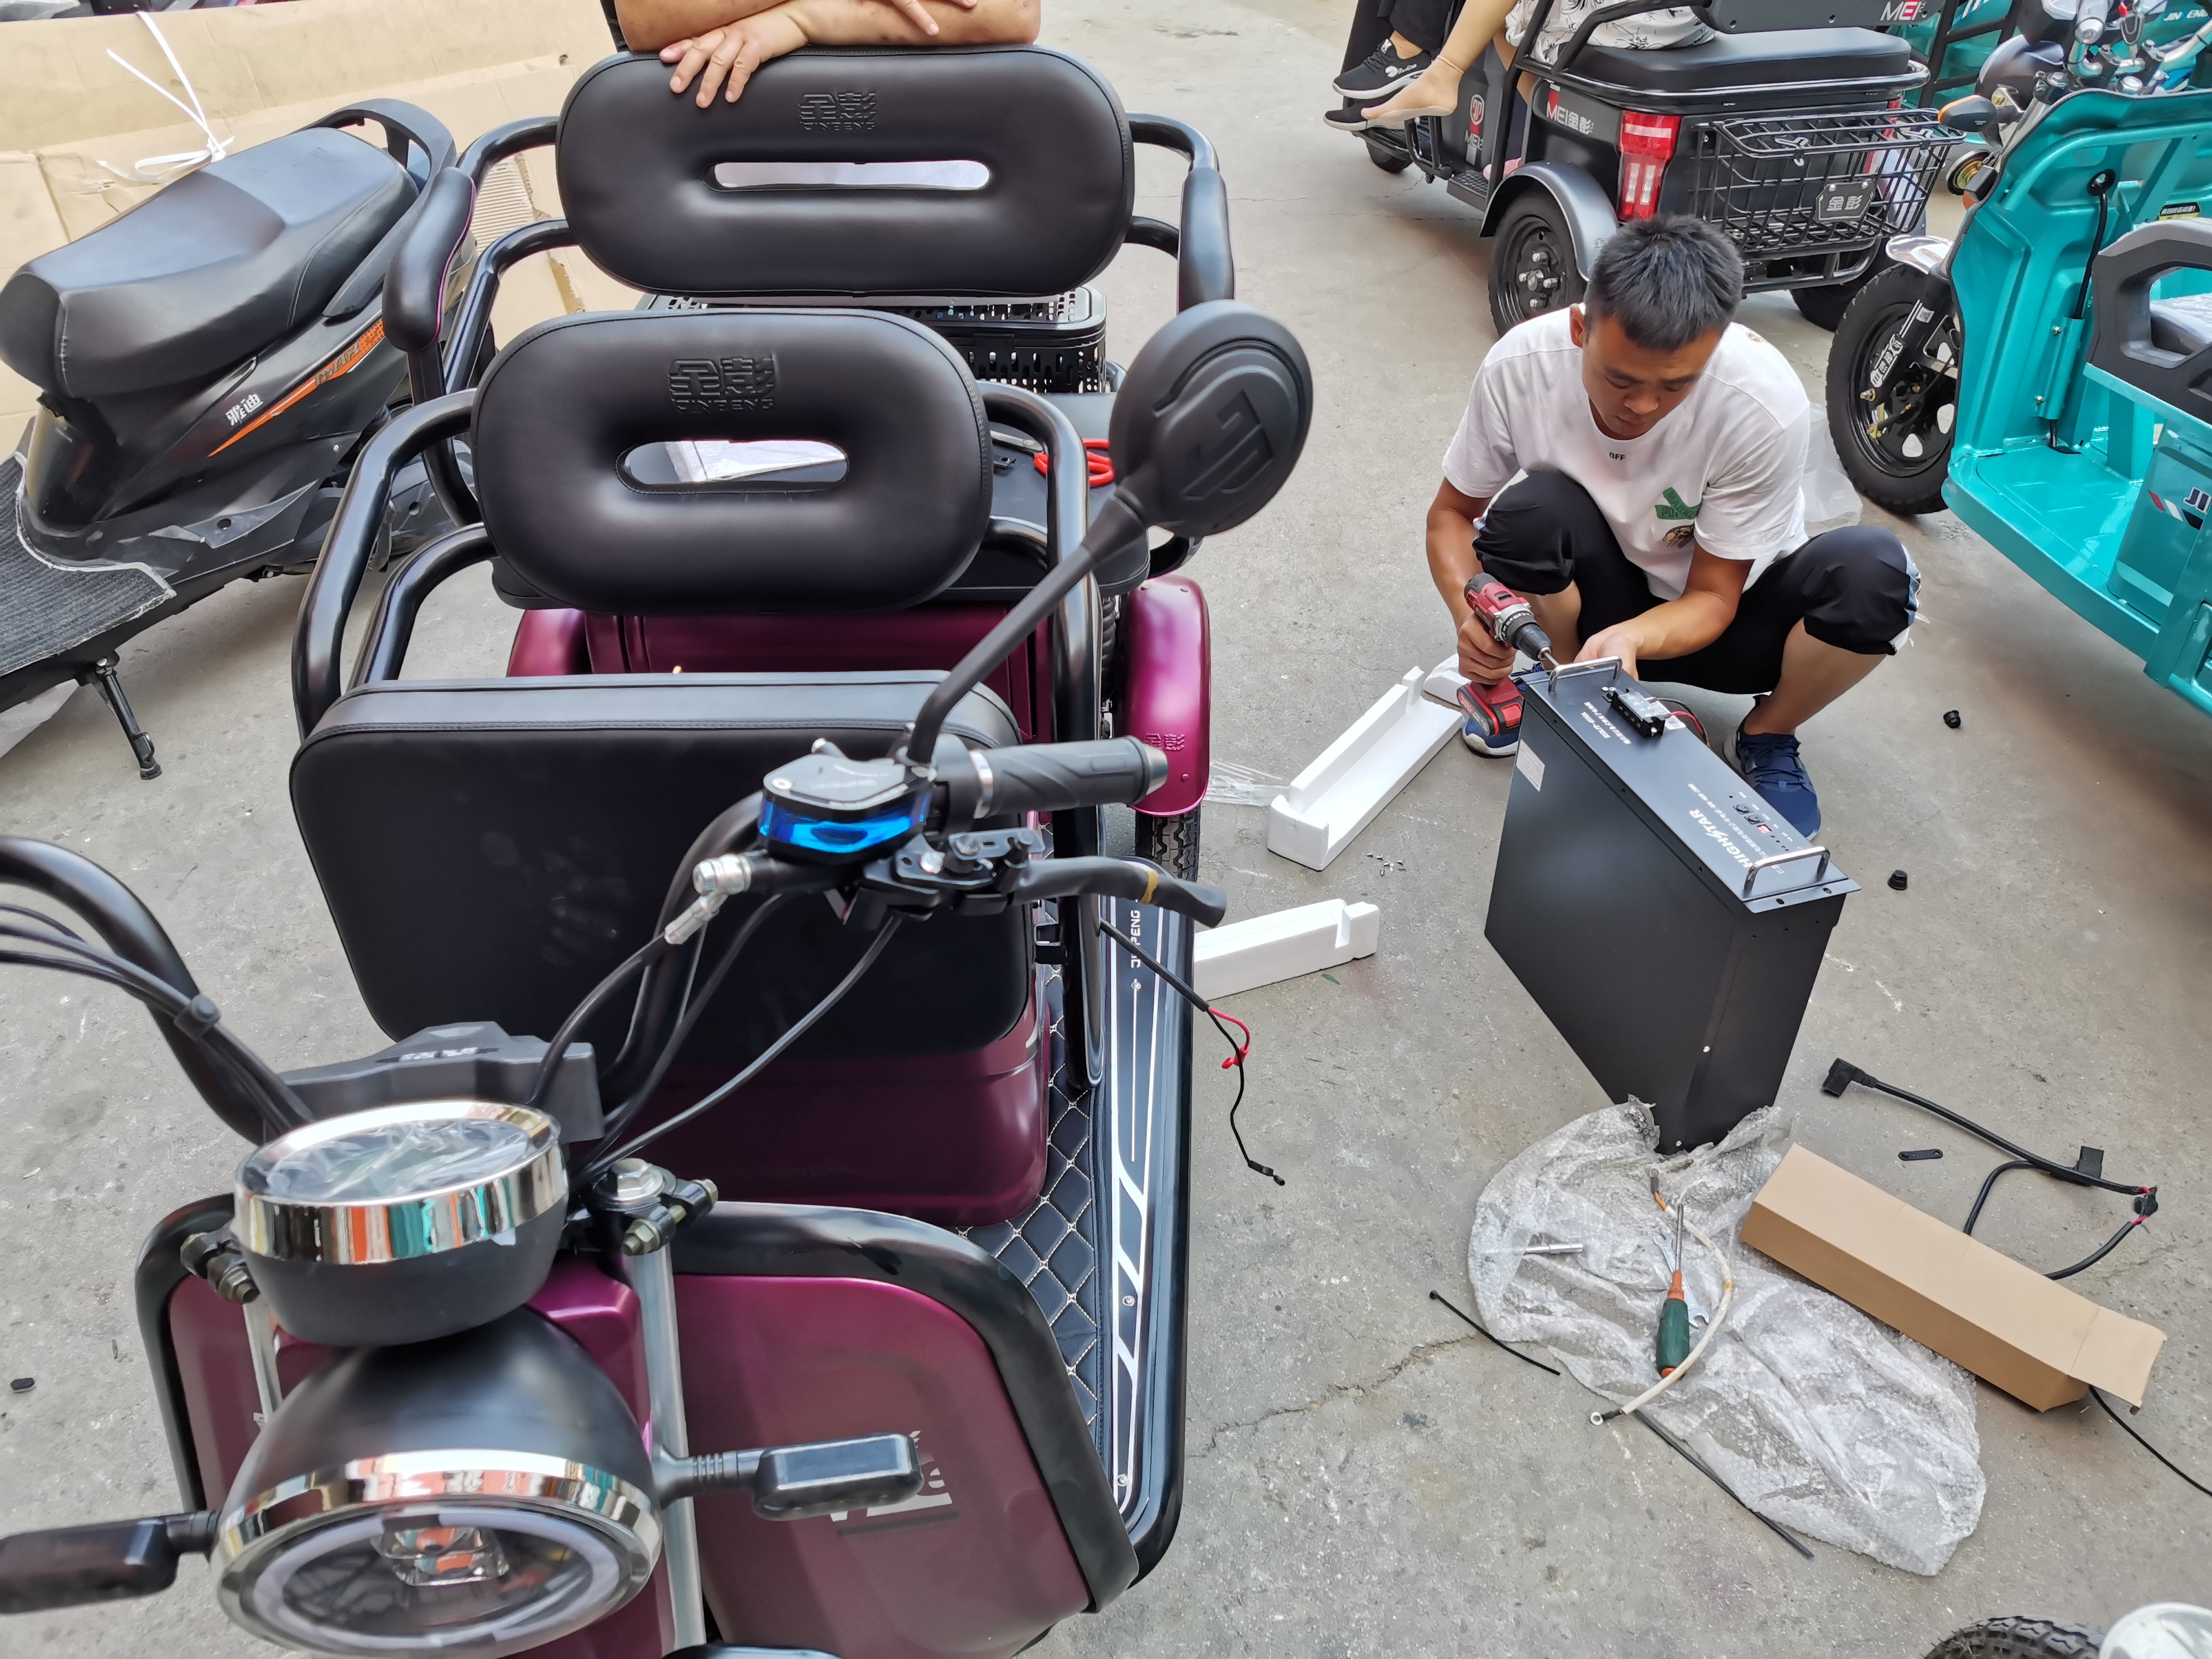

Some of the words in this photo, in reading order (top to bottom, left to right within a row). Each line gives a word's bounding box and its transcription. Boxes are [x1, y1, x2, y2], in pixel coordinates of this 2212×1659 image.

[797, 91, 877, 121] 金彭
[1826, 195, 1863, 211] 金彭
[667, 357, 774, 397] 金彭
[225, 394, 263, 426] 雅迪
[1609, 452, 1626, 461] OFF
[2183, 487, 2212, 514] JI
[1130, 910, 1141, 968] JIPENG
